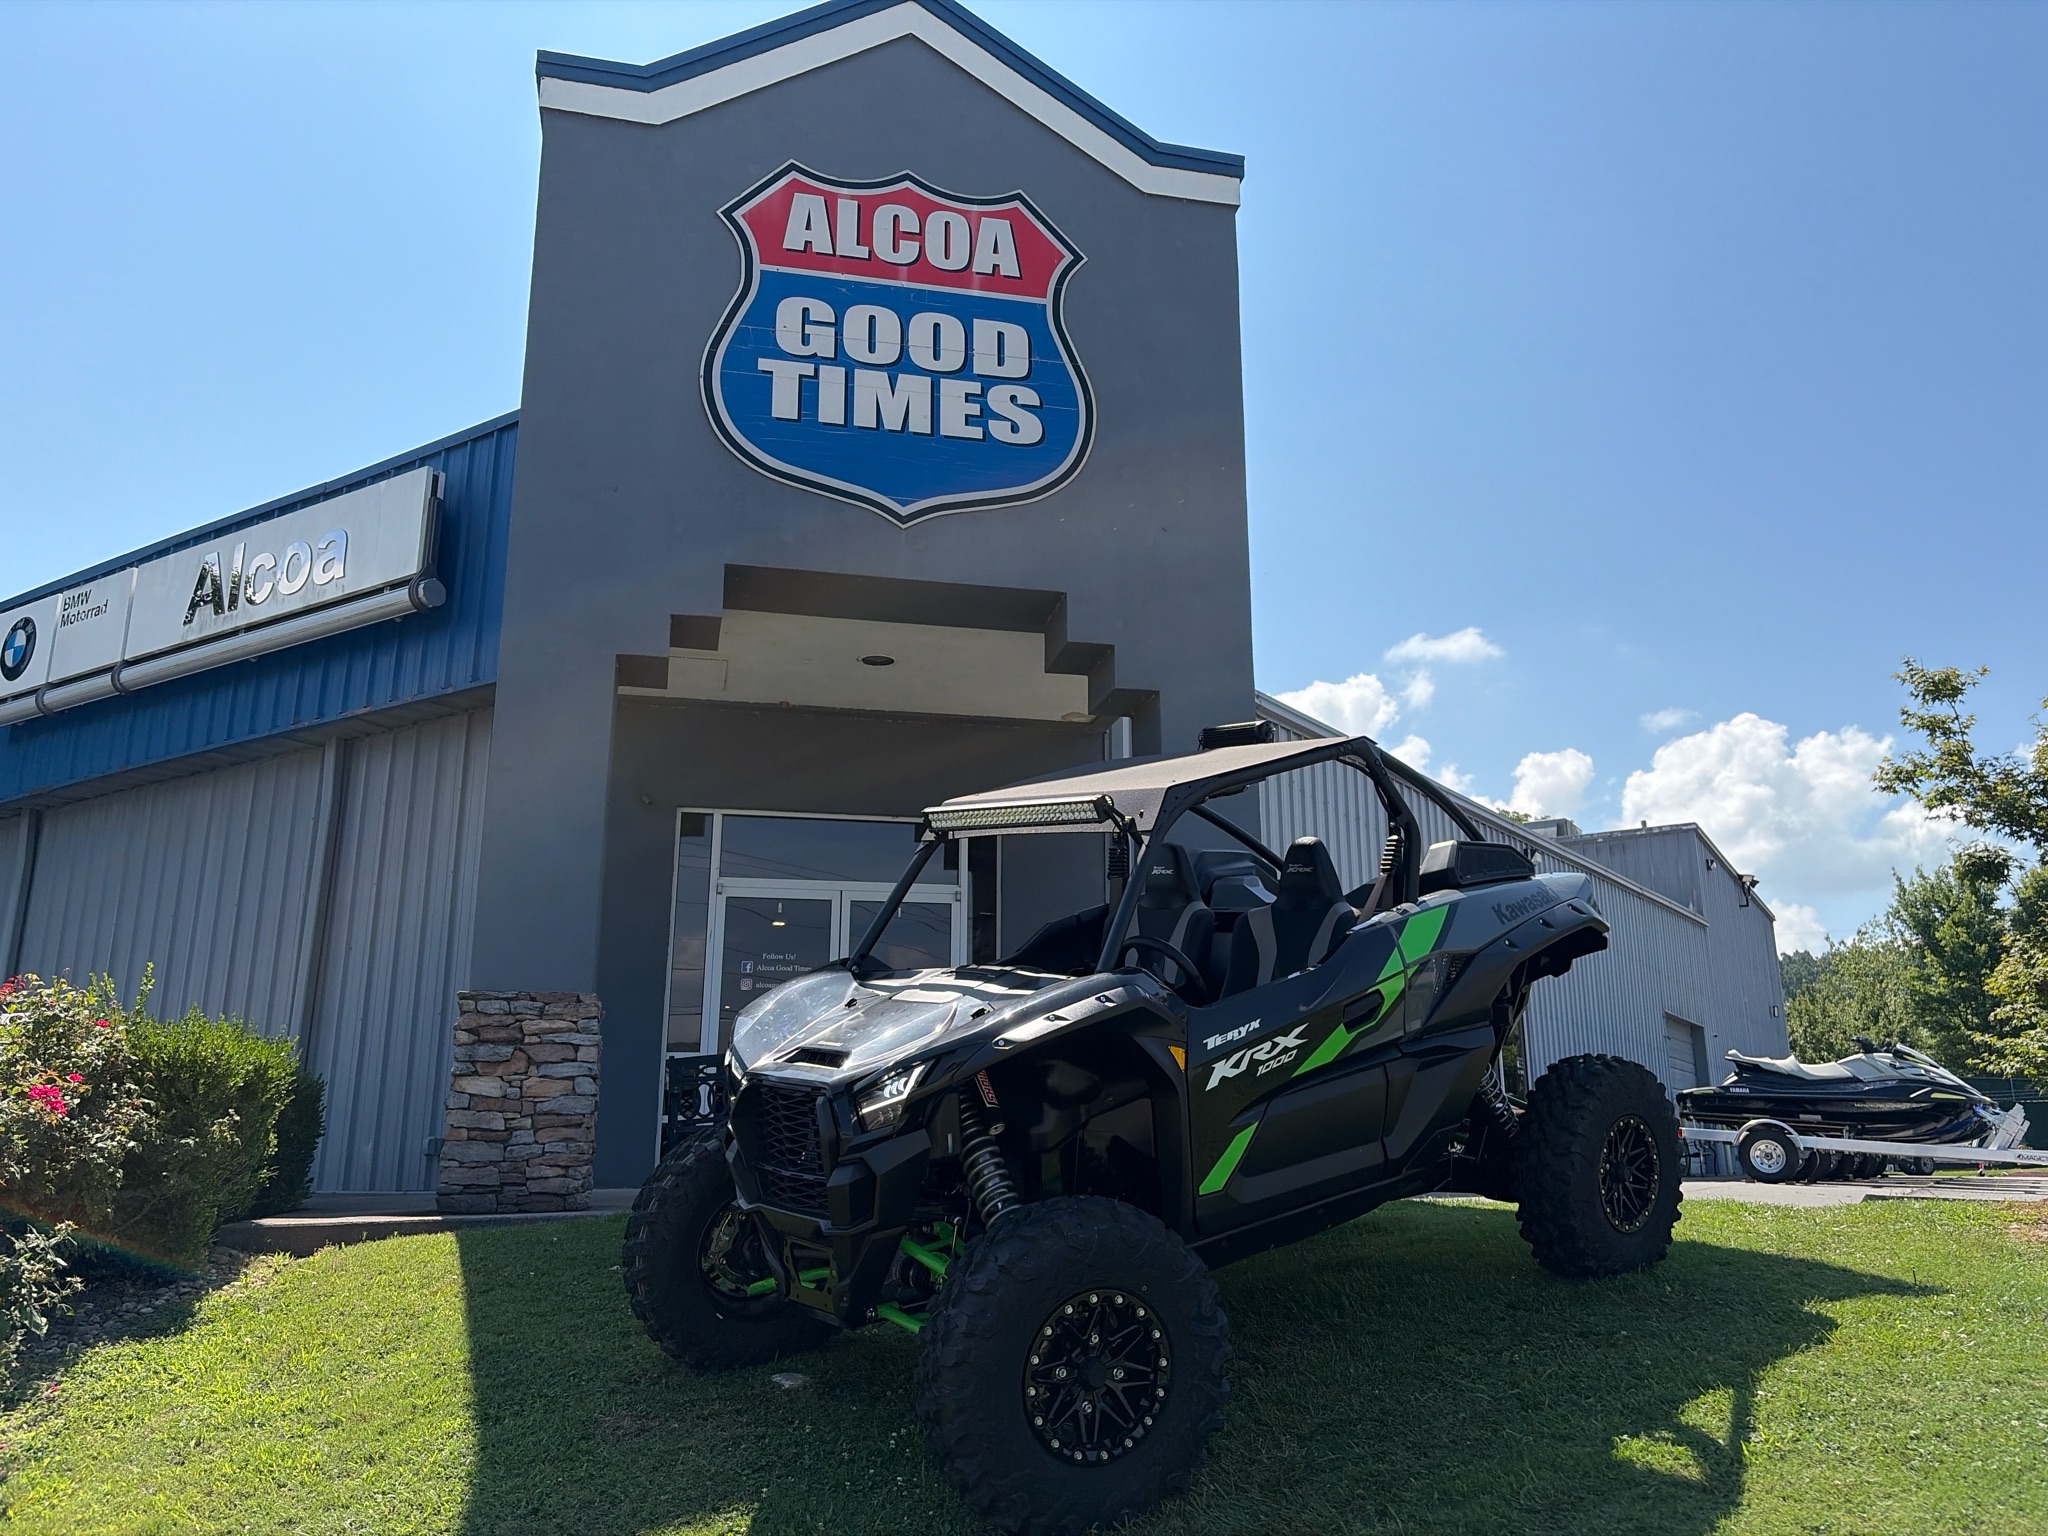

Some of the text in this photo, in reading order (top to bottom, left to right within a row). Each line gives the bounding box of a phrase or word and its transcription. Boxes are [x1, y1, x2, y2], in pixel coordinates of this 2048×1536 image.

[783, 192, 1021, 279] ALCOA
[775, 297, 1031, 379] GOOD
[757, 358, 1044, 446] TIMES
[62, 589, 92, 612] BMW
[183, 528, 348, 627] Alcoa
[59, 599, 108, 628] Motorrad
[776, 964, 793, 972] Good
[1204, 1022, 1310, 1092] KRX
[1256, 1048, 1298, 1077] 1000
